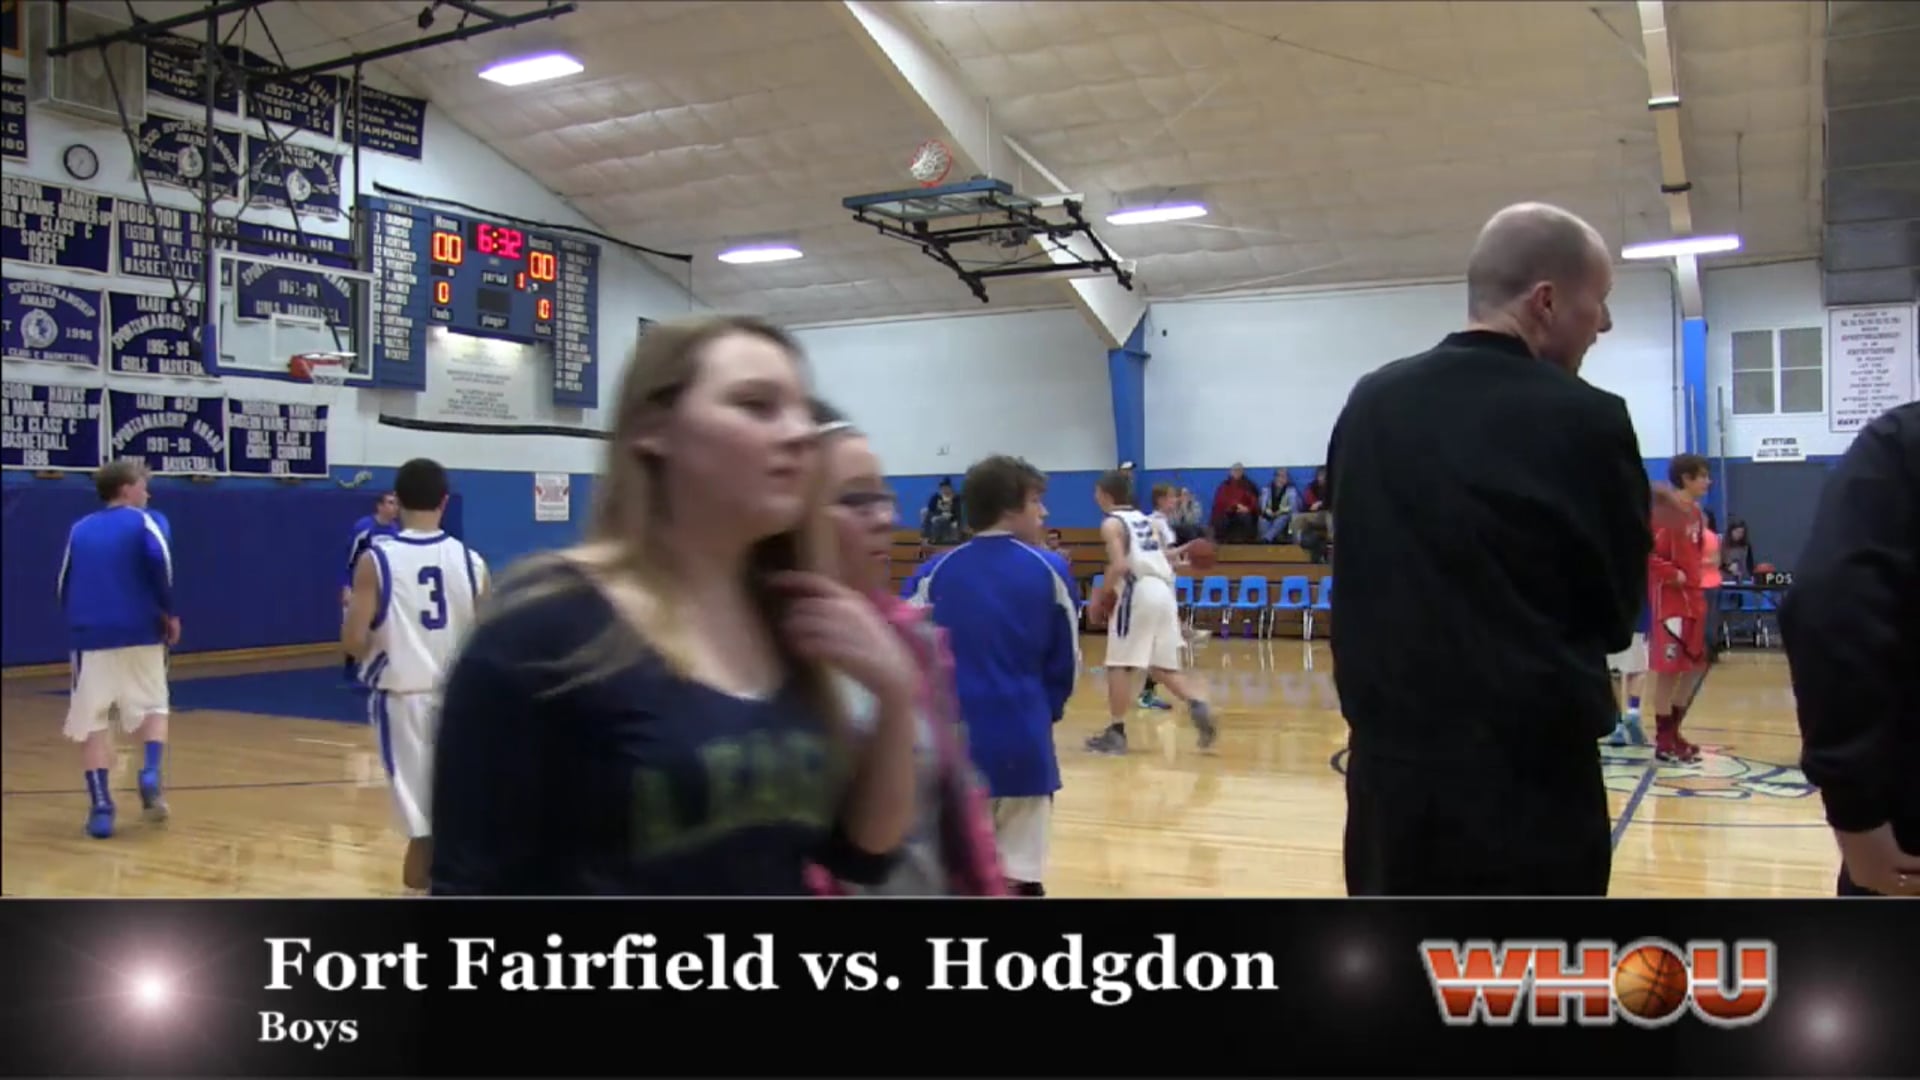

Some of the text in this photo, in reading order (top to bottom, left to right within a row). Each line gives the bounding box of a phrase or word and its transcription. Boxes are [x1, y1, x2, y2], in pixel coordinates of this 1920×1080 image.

[41, 216, 75, 237] CLASS
[85, 223, 94, 240] C
[20, 229, 66, 251] SOCCER
[432, 231, 462, 265] 00
[477, 223, 523, 260] 6:32
[529, 251, 555, 282] 00
[20, 294, 57, 309] AWARD
[437, 281, 449, 304] 0
[538, 298, 550, 320] 0
[69, 419, 77, 435] C
[418, 566, 448, 631] 3
